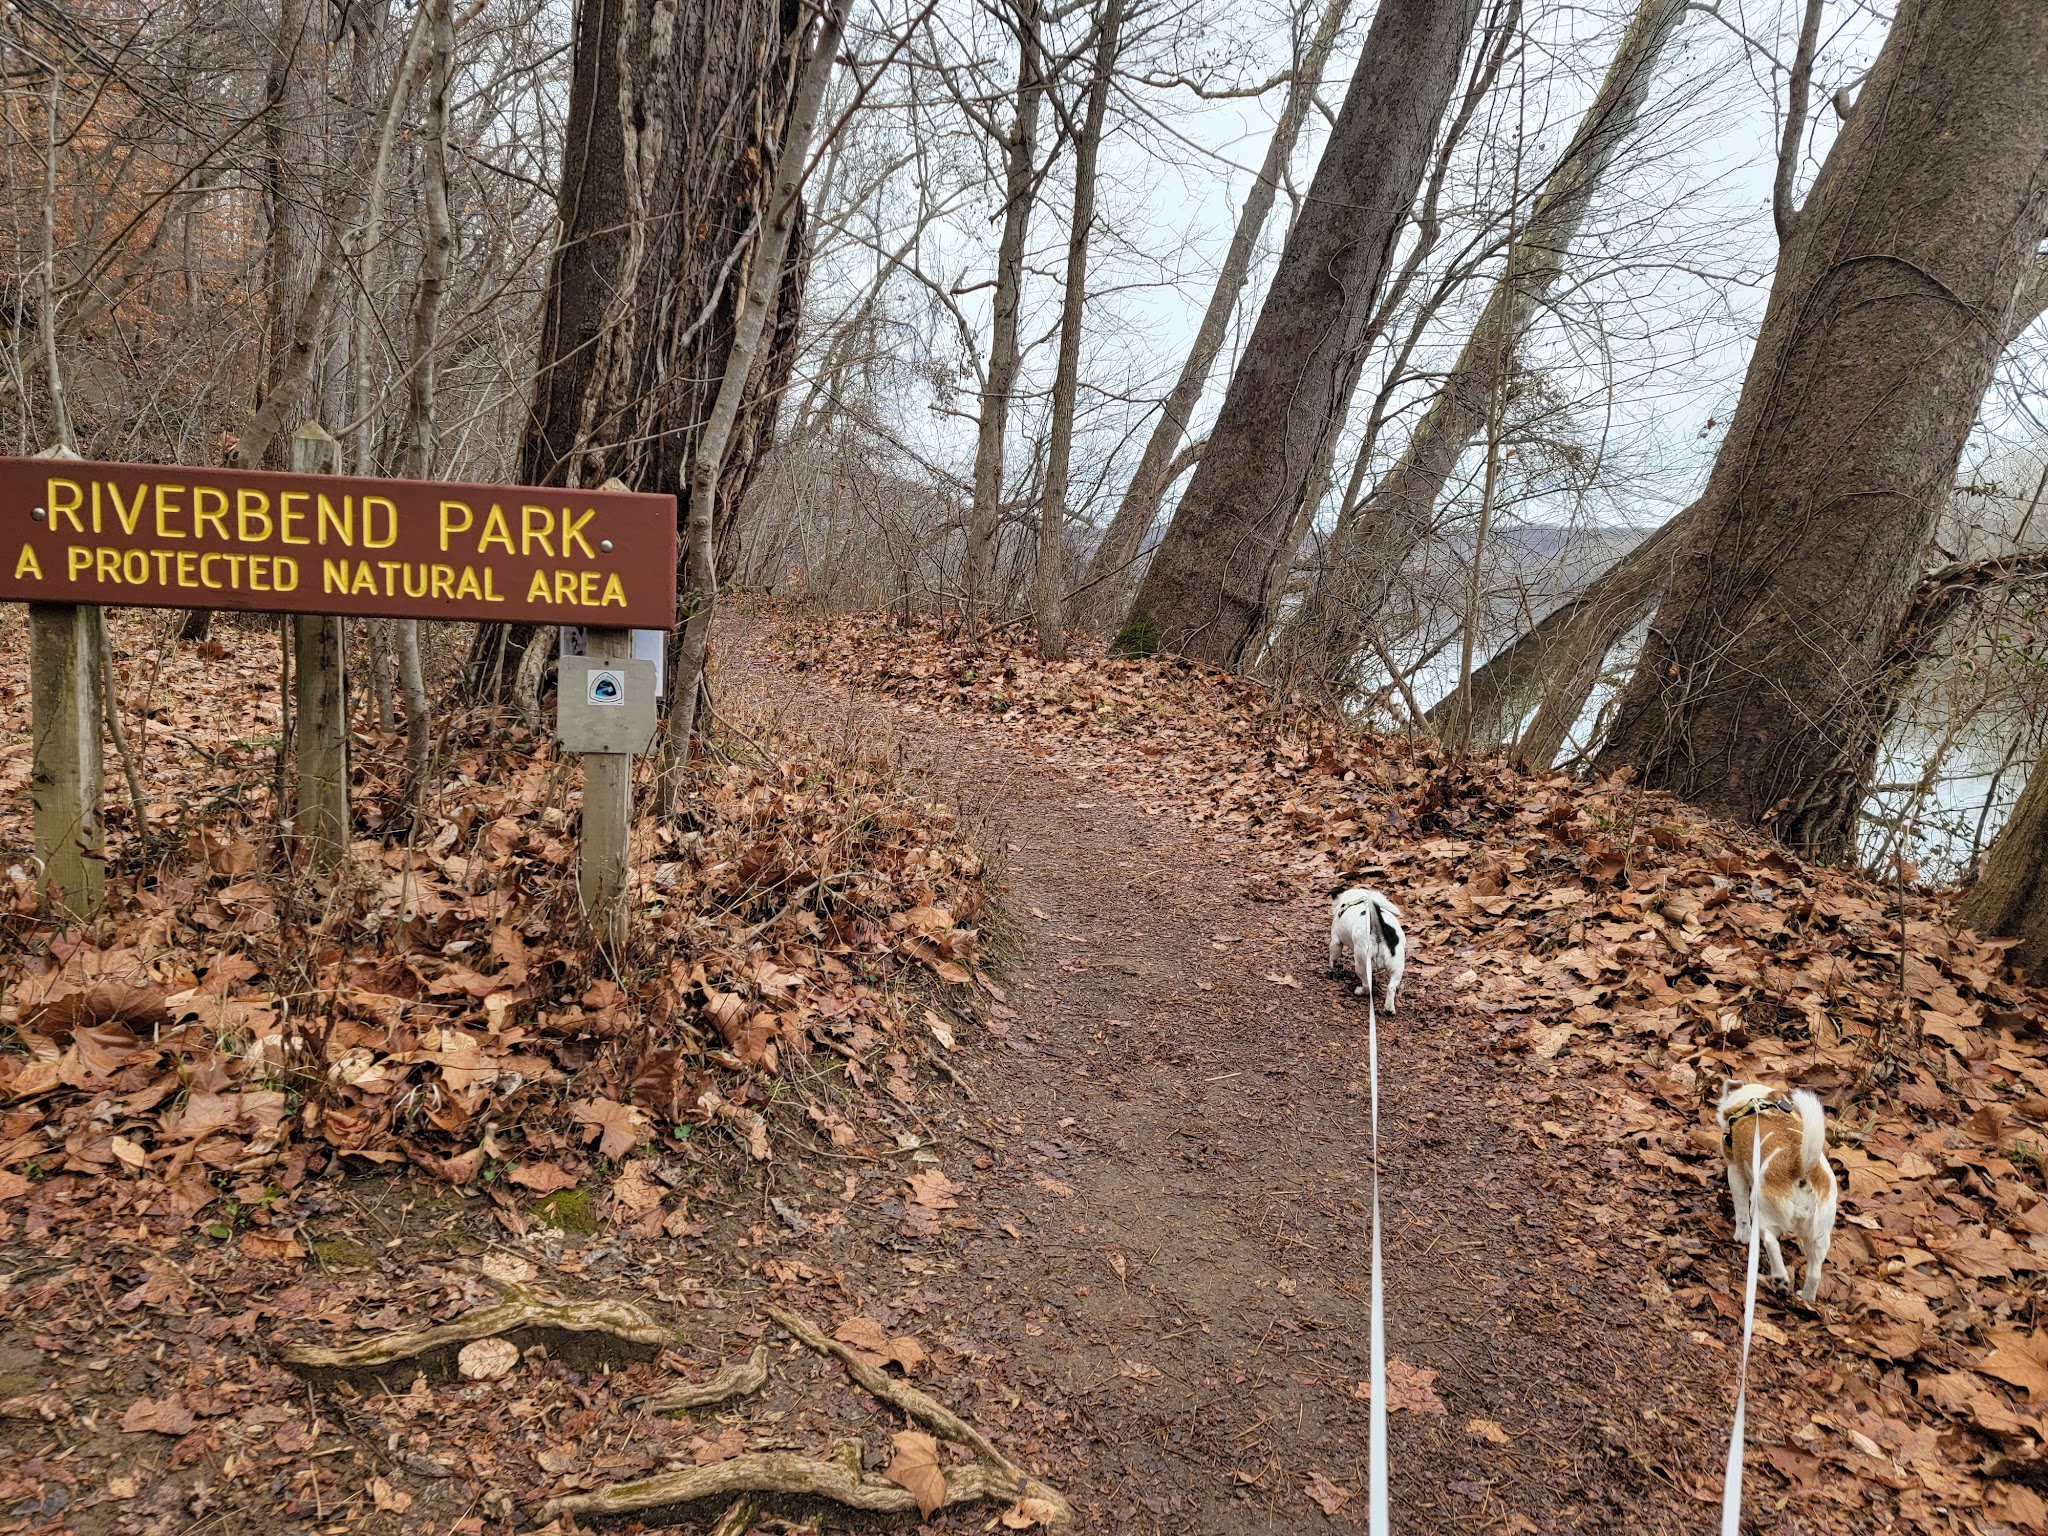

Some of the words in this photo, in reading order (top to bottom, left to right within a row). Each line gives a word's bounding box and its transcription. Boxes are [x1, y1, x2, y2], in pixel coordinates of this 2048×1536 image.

[47, 477, 399, 549] RIVERBEND
[439, 500, 597, 560] PARK
[14, 543, 43, 581] A
[67, 545, 299, 592] PROTECTED
[322, 558, 505, 602] NATURAL
[526, 568, 628, 608] AREA
